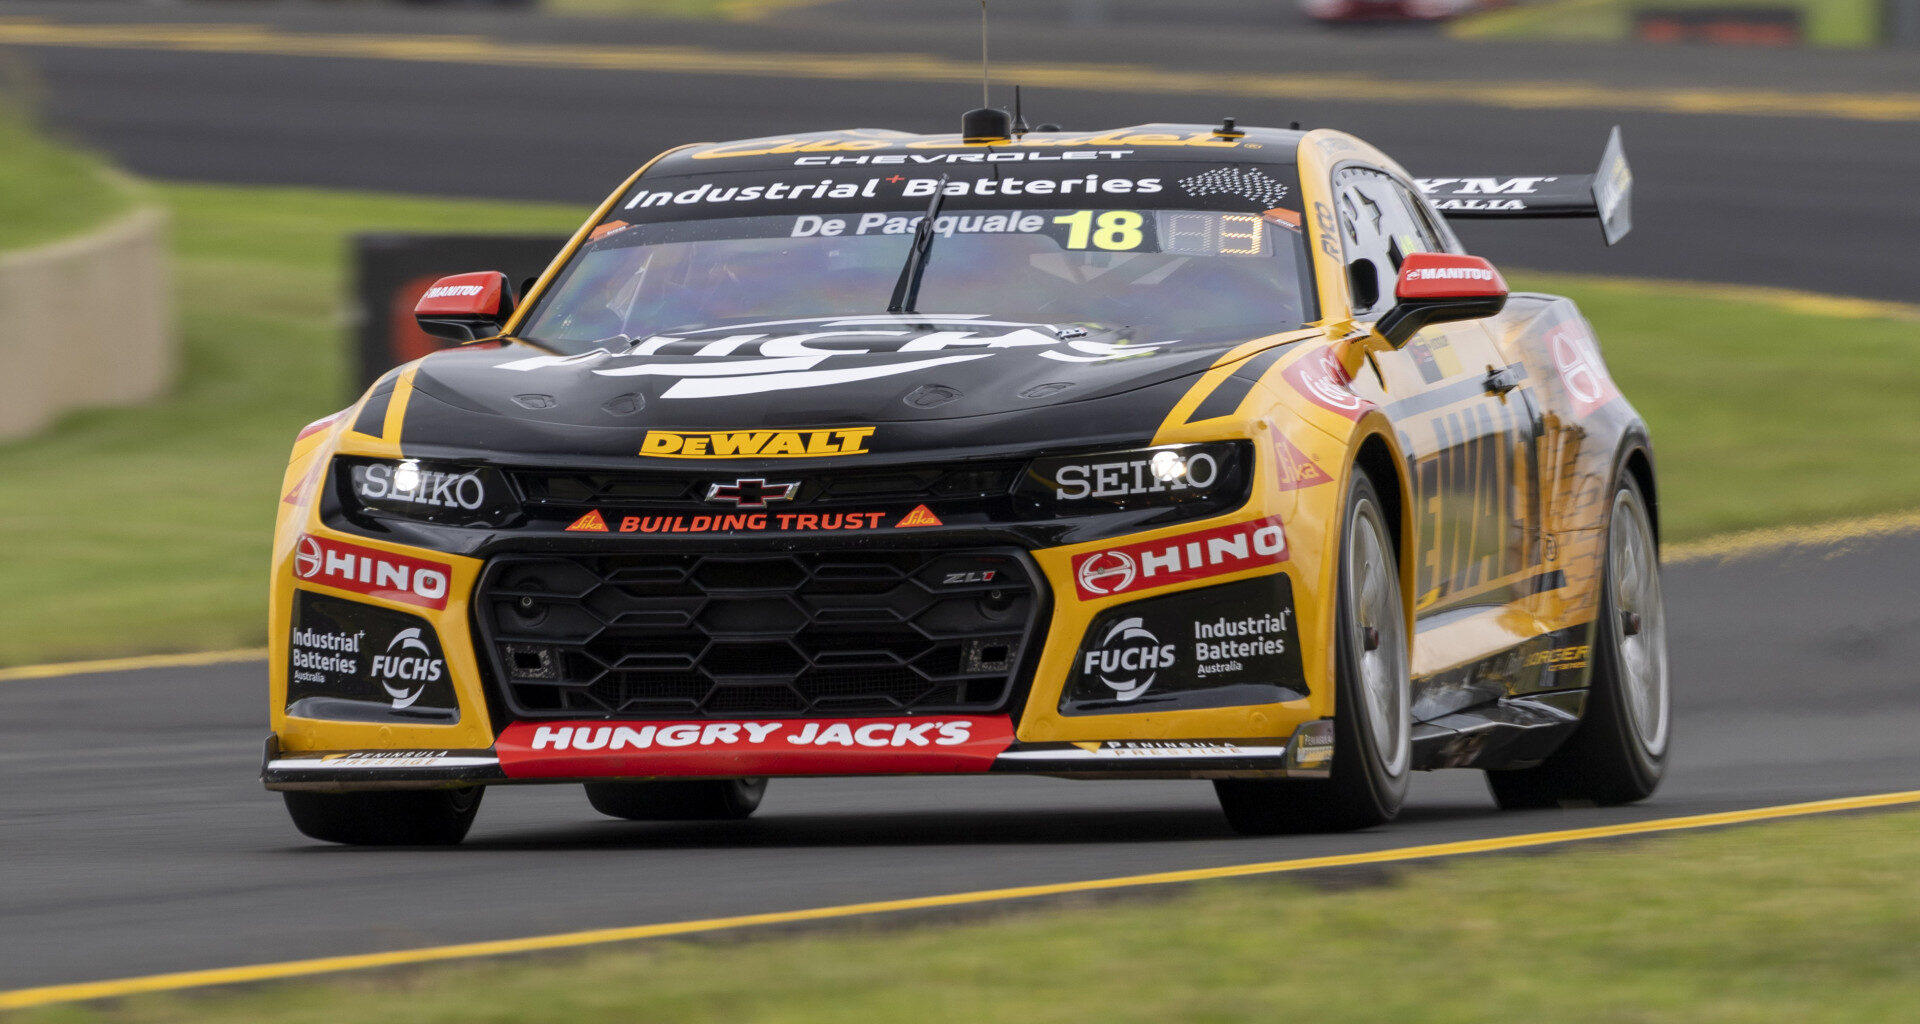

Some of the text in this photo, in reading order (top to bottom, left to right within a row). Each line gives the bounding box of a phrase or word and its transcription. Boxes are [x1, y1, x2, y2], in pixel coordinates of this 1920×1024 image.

[794, 150, 1135, 166] CHEVROLET
[625, 173, 1163, 210] Industrial Batteries
[790, 210, 1045, 239] De Pasquale
[1053, 210, 1144, 251] 18
[1314, 201, 1341, 264] RYCO
[1421, 268, 1493, 280] MANITOU
[427, 285, 484, 299] MANITOU
[361, 463, 485, 510] SEIKO
[1056, 453, 1217, 500] SEIKO
[576, 515, 602, 530] Sika
[619, 512, 886, 533] BUILDING TRUST
[901, 511, 935, 527] Sika
[1141, 525, 1286, 578] HINO
[325, 550, 446, 599] HINO
[943, 570, 996, 584] ZL1
[293, 648, 357, 675] Batteries
[1084, 644, 1176, 675] FUCHS
[1195, 636, 1285, 662] Batteries
[294, 670, 326, 684] Australia
[371, 655, 442, 682] FUCHS
[1197, 660, 1243, 678] Australia
[531, 721, 973, 750] HUNGRY JACK'S
